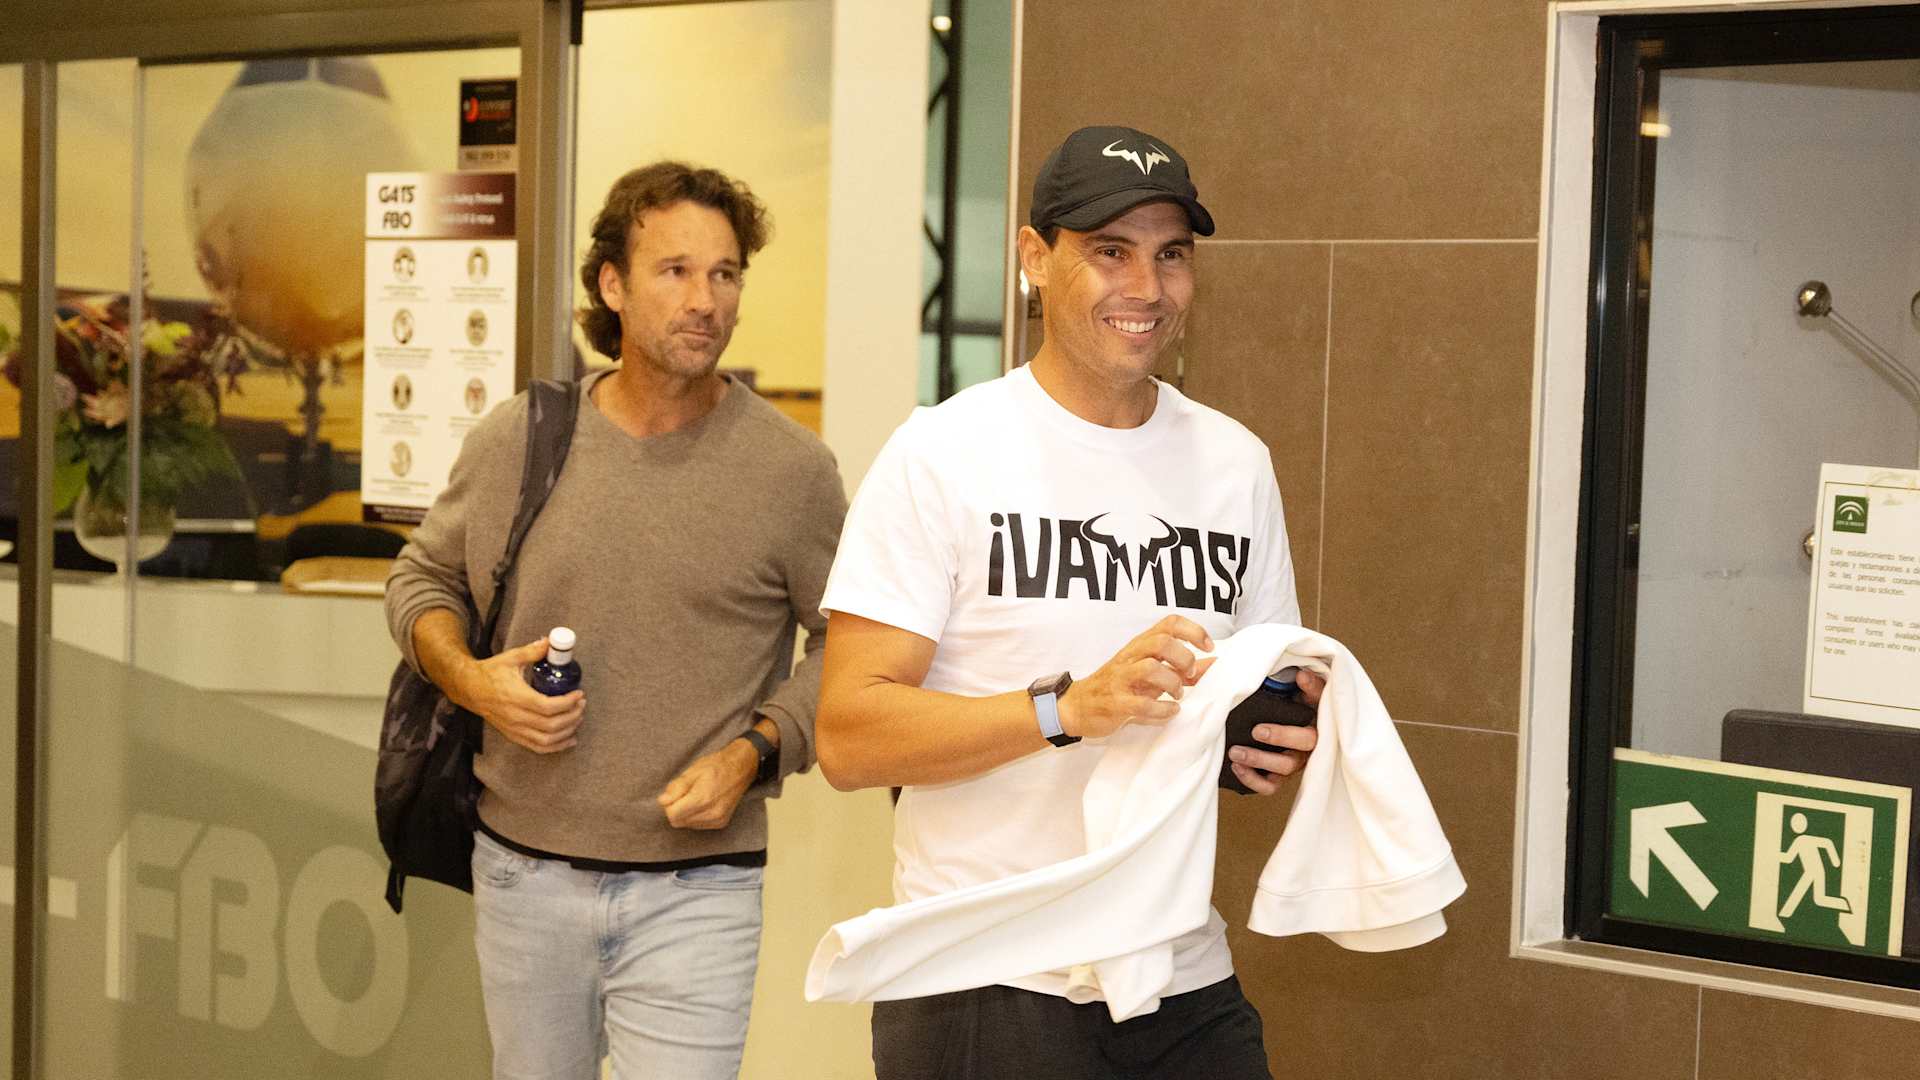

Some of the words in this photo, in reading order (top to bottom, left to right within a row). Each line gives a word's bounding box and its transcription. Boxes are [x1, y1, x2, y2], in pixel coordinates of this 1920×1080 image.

[383, 211, 412, 229] FBO
[1844, 615, 1887, 625] establishment
[105, 813, 409, 1058] FBO
